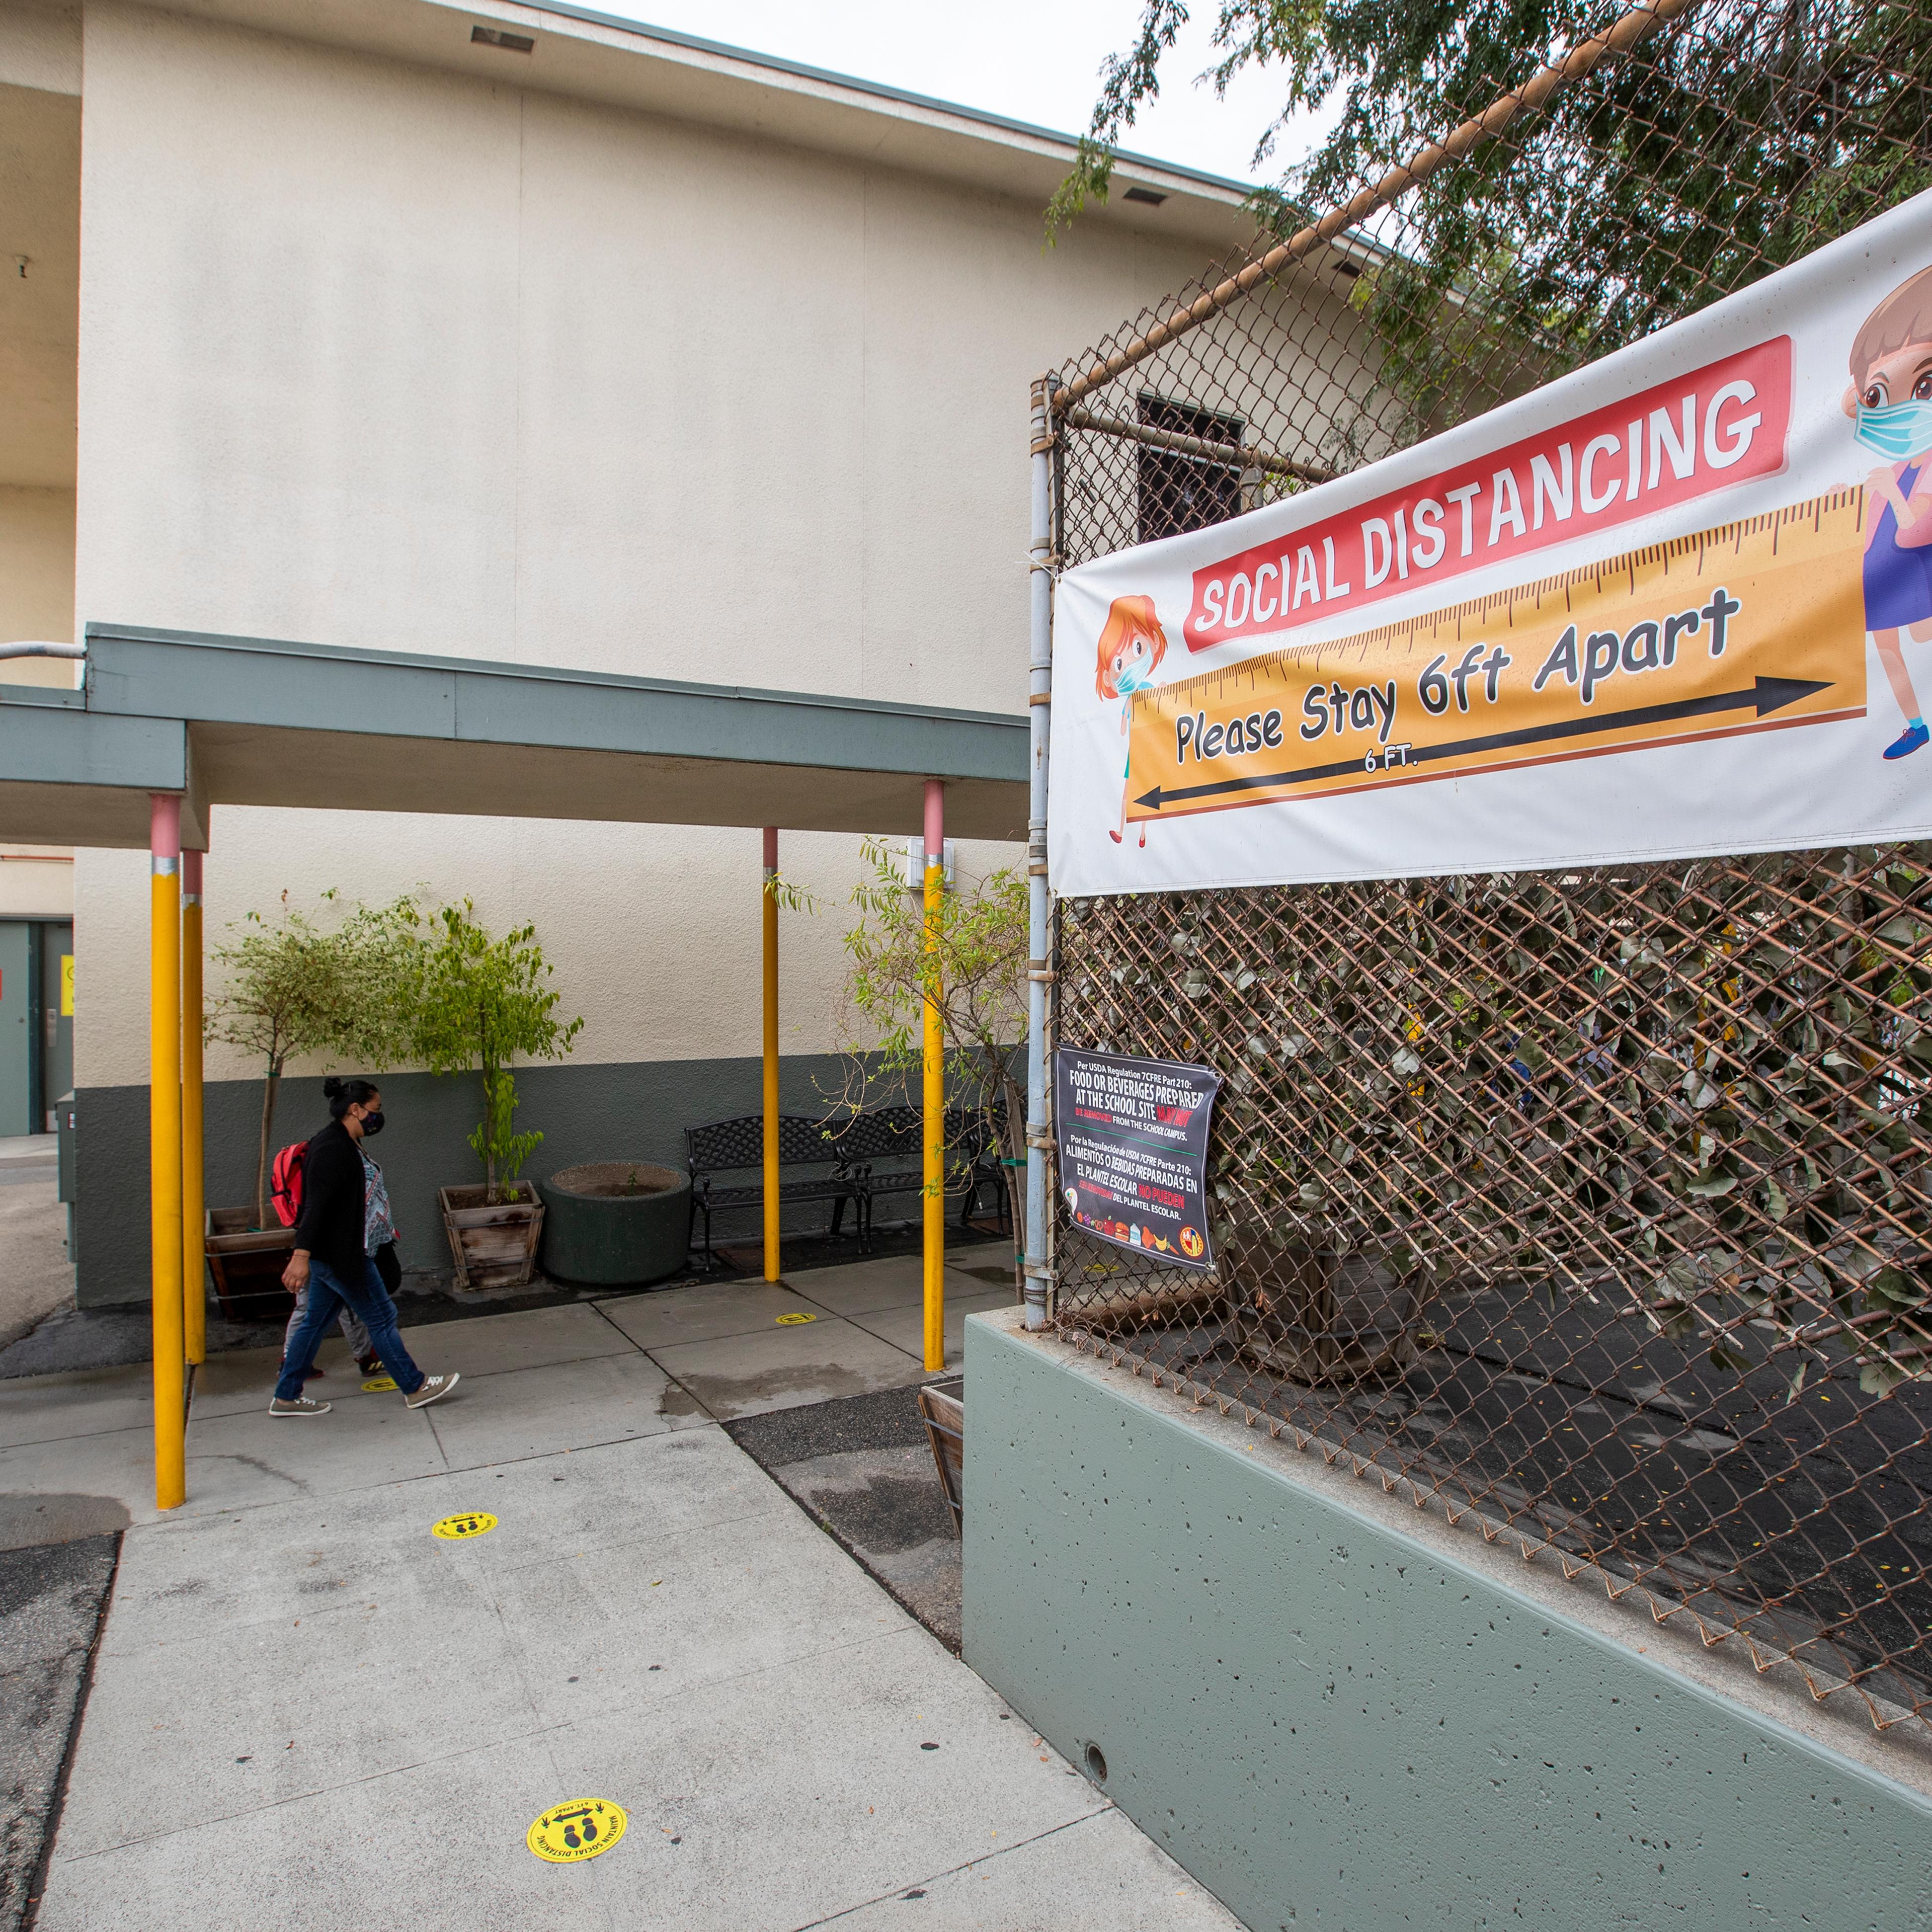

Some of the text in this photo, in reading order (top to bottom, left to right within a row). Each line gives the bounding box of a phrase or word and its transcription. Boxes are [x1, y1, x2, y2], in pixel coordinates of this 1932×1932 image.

[1194, 379, 1762, 632] SOCIAL DISTANCING
[1175, 586, 1742, 766] Please Stay 6ft Apart
[1363, 742, 1418, 774] 6 FT.
[1070, 1070, 1204, 1109] FOOD OR BEVERAGES PREPARED
[1077, 1061, 1192, 1089] Per USDA Regulation 7CFRE Part 210:
[1076, 1088, 1086, 1105] AT
[1087, 1090, 1103, 1108] THE
[1104, 1094, 1137, 1116] SCHOOL
[1138, 1101, 1156, 1120] SITE
[1112, 1115, 1130, 1127] FROM
[1130, 1119, 1142, 1130] THE
[1143, 1122, 1164, 1136] SCHOOL
[1164, 1128, 1187, 1141] CAMPUS.
[1066, 1144, 1197, 1194] ALIMENTOS O BEBIDAS PREPARADAS EN
[1070, 1135, 1191, 1175] Por la Regulación de USDA 7CFRE Parte 210:
[1077, 1163, 1185, 1209] EL PLANTEL ESCOLAR NO PUEDEN
[1113, 1193, 1123, 1203] DEL
[1123, 1196, 1150, 1212] PLANTEL
[1151, 1204, 1181, 1221] ESCOLAR.
[555, 1805, 574, 1814] APART
[537, 1815, 619, 1858] MAINTAIN SOCIAL DISTANCING
